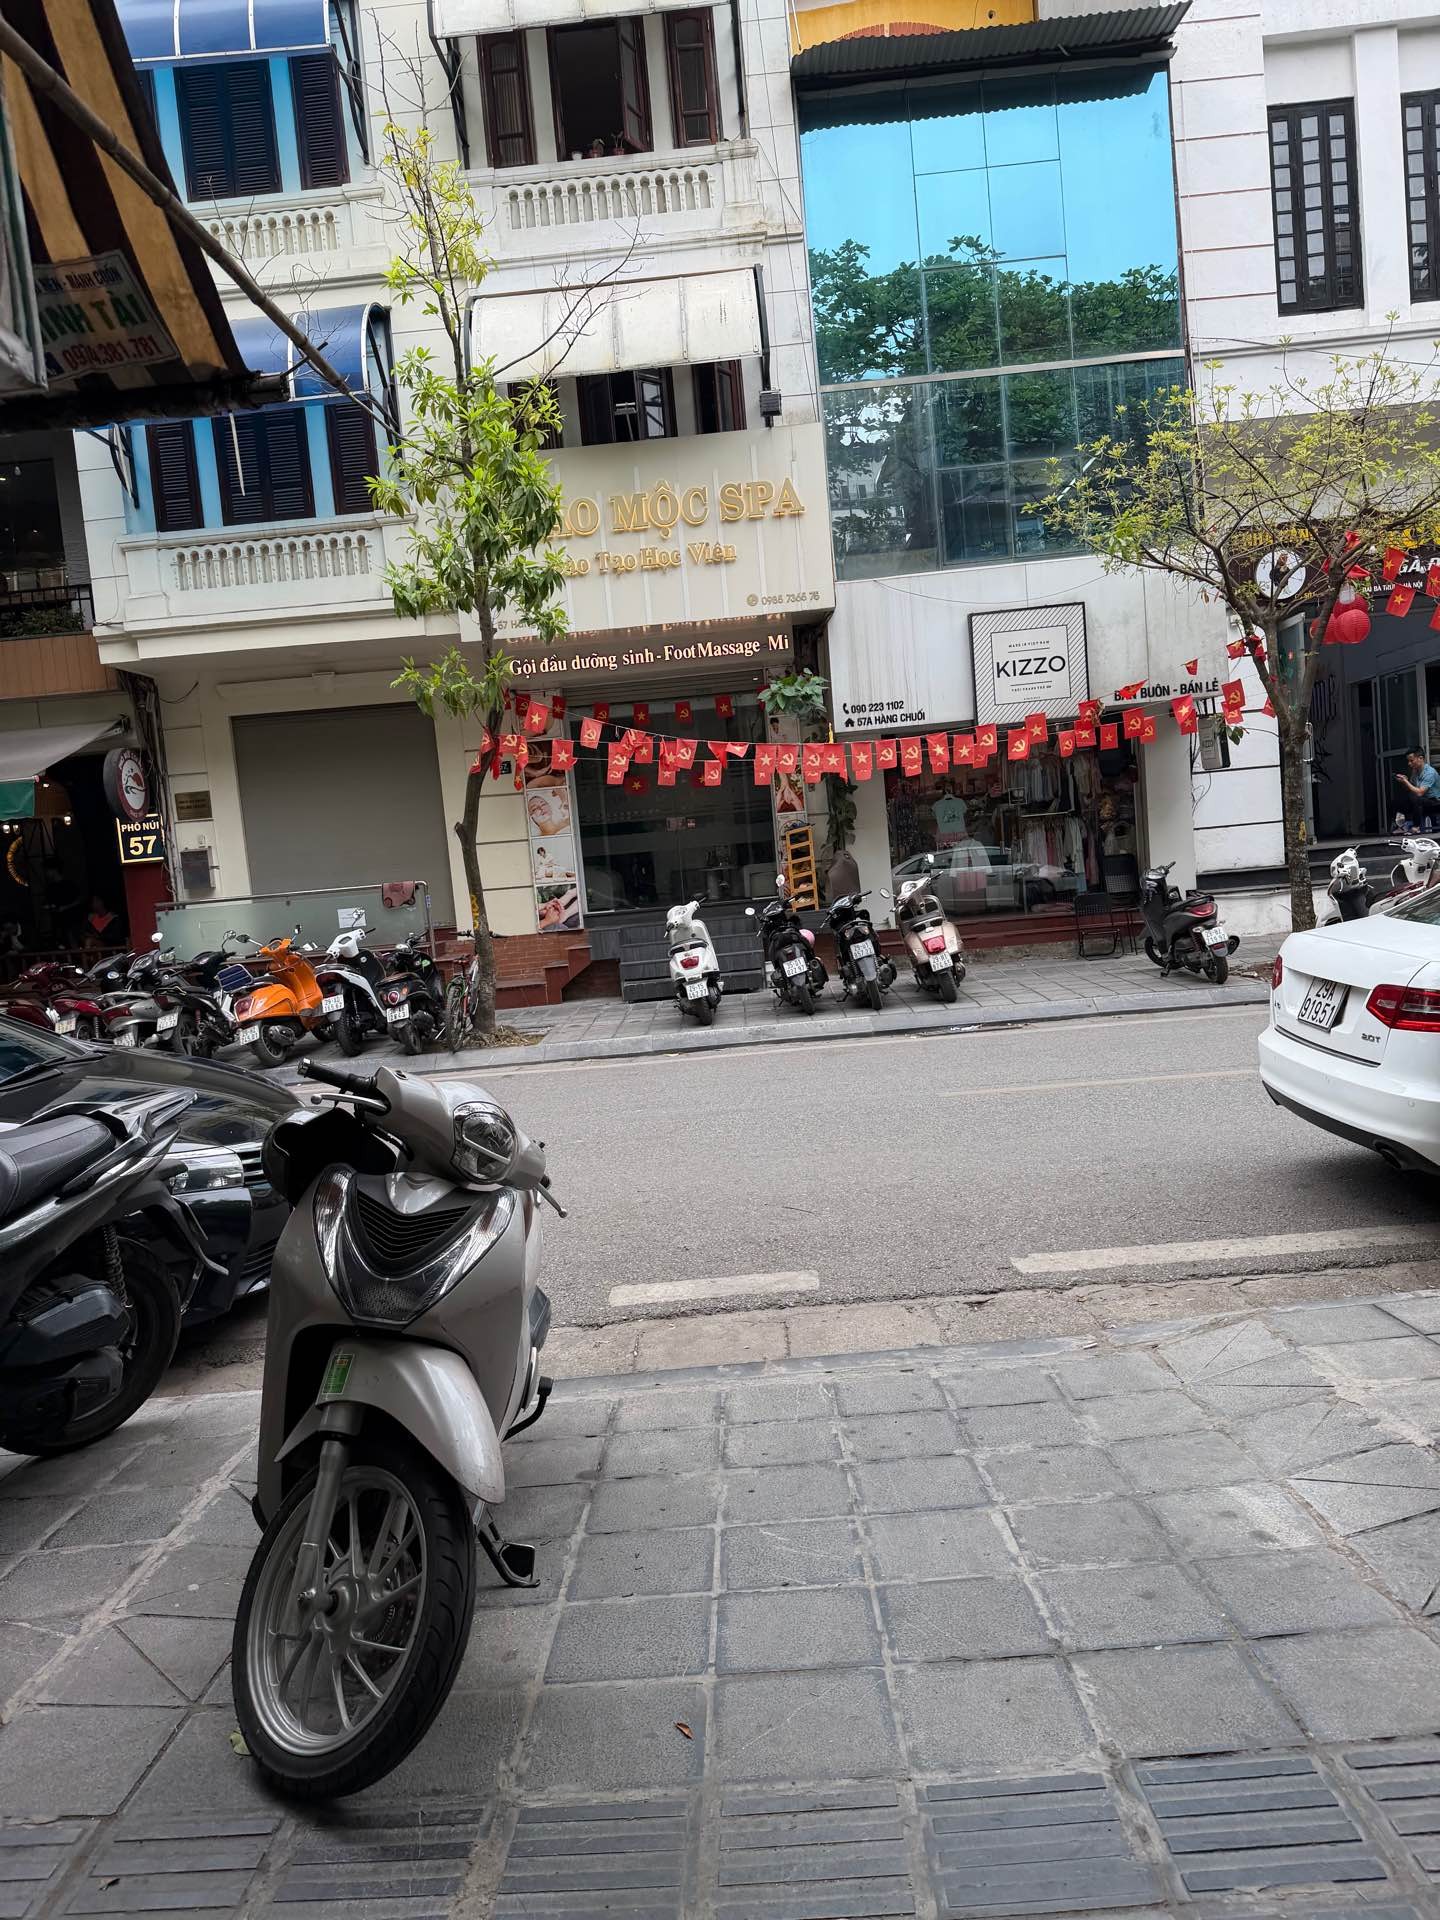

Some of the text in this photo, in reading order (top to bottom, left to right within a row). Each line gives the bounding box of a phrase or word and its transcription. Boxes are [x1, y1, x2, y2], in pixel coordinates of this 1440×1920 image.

[609, 479, 710, 540] MỘC
[719, 477, 806, 521] SPA
[595, 550, 637, 576] Tạo
[639, 546, 682, 574] Học
[509, 658, 537, 679] Gội
[539, 654, 567, 674] đầu
[571, 652, 618, 671] dưỡng
[622, 647, 655, 667] sinh
[767, 634, 790, 652] Mi
[996, 655, 1066, 679] KIZZO
[1140, 683, 1170, 699] BUÔN
[1180, 680, 1202, 695] BÁN
[1205, 677, 1219, 692] LẺ
[851, 700, 904, 714] 090 223 1102
[857, 708, 926, 727] 57A HÀNG CHUỐI
[142, 820, 160, 831] NÚI
[129, 835, 157, 856] 57
[1315, 978, 1338, 1001] 29A
